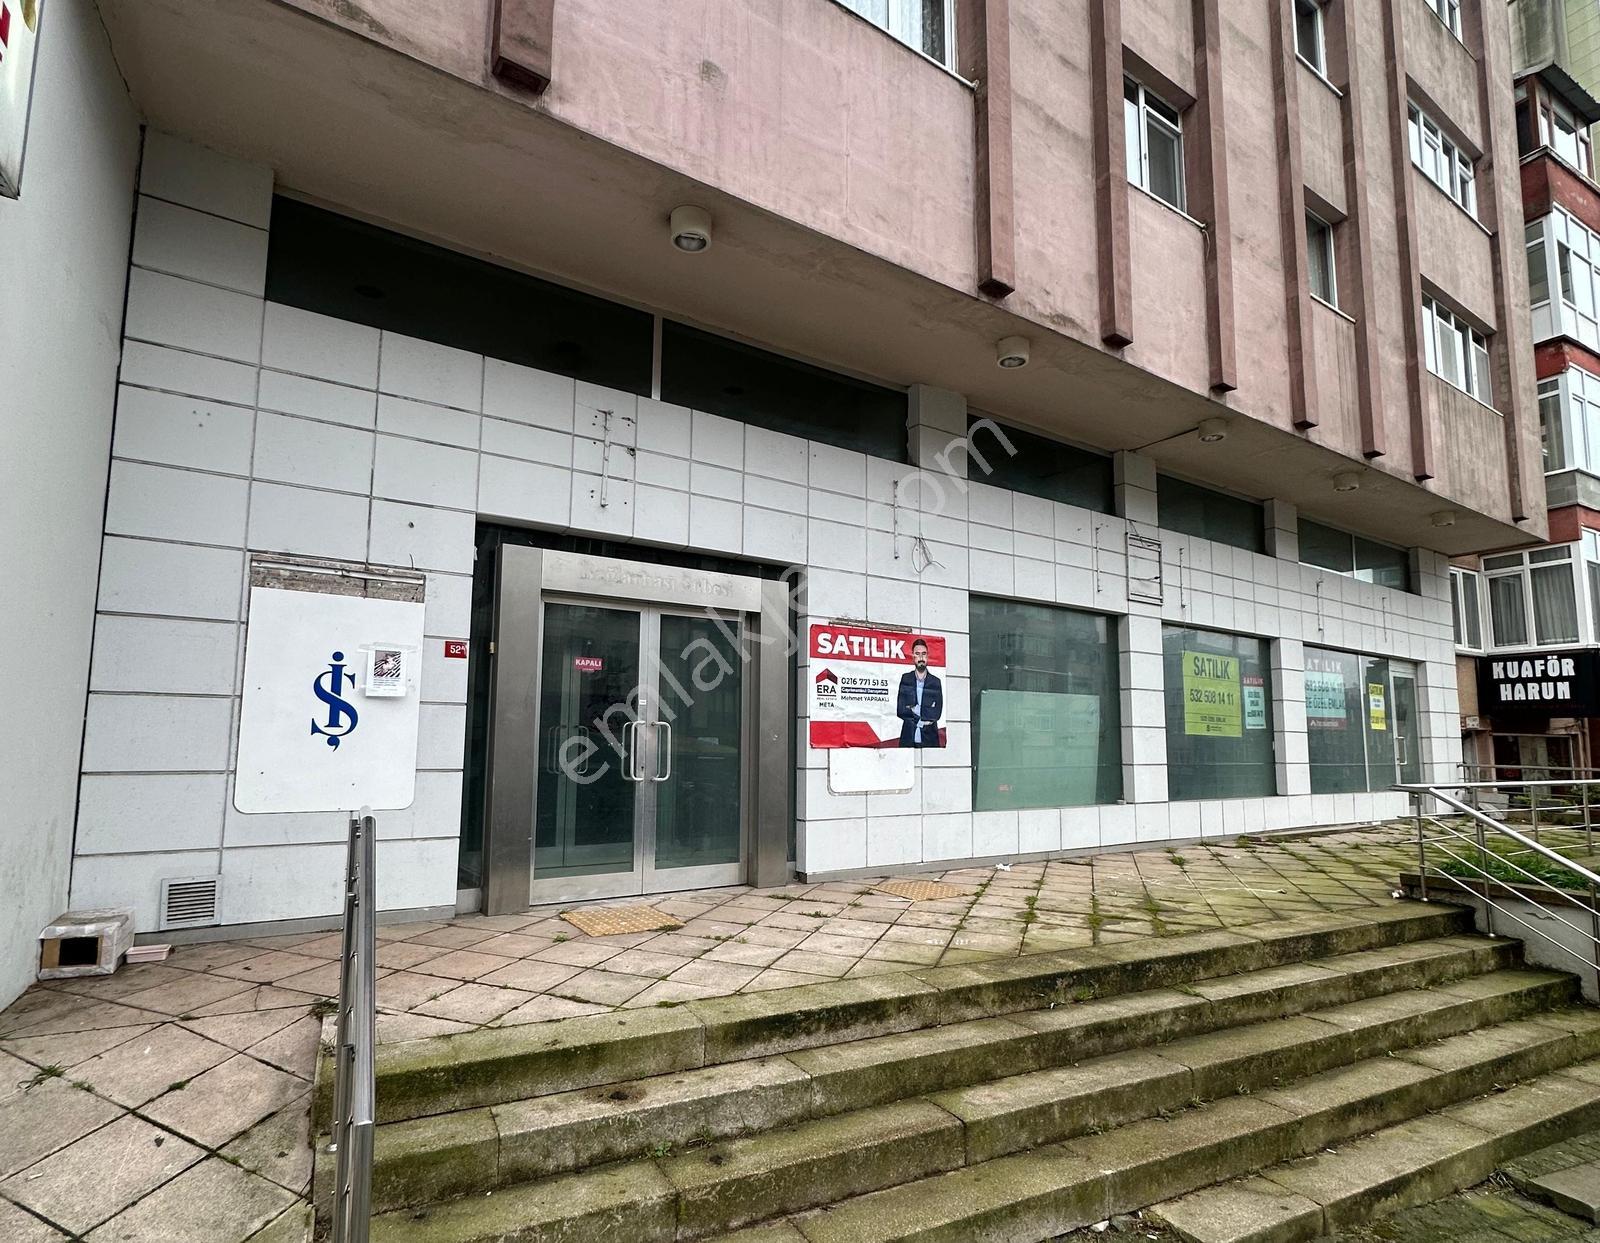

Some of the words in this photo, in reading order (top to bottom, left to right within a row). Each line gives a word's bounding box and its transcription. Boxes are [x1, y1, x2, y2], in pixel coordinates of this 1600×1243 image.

[817, 632, 906, 660] SATILIK
[575, 659, 602, 667] KAPALI
[1193, 655, 1231, 680] SATILIK
[1306, 658, 1343, 673] ATILIK
[1492, 655, 1576, 680] KUAFÖR
[816, 684, 837, 694] ERA
[841, 677, 857, 685] 0216
[859, 678, 870, 686] 771
[880, 679, 888, 687] 53
[1500, 681, 1571, 701] HARUN
[1190, 688, 1203, 703] 532
[1218, 692, 1225, 704] 14
[1227, 693, 1234, 706] 11
